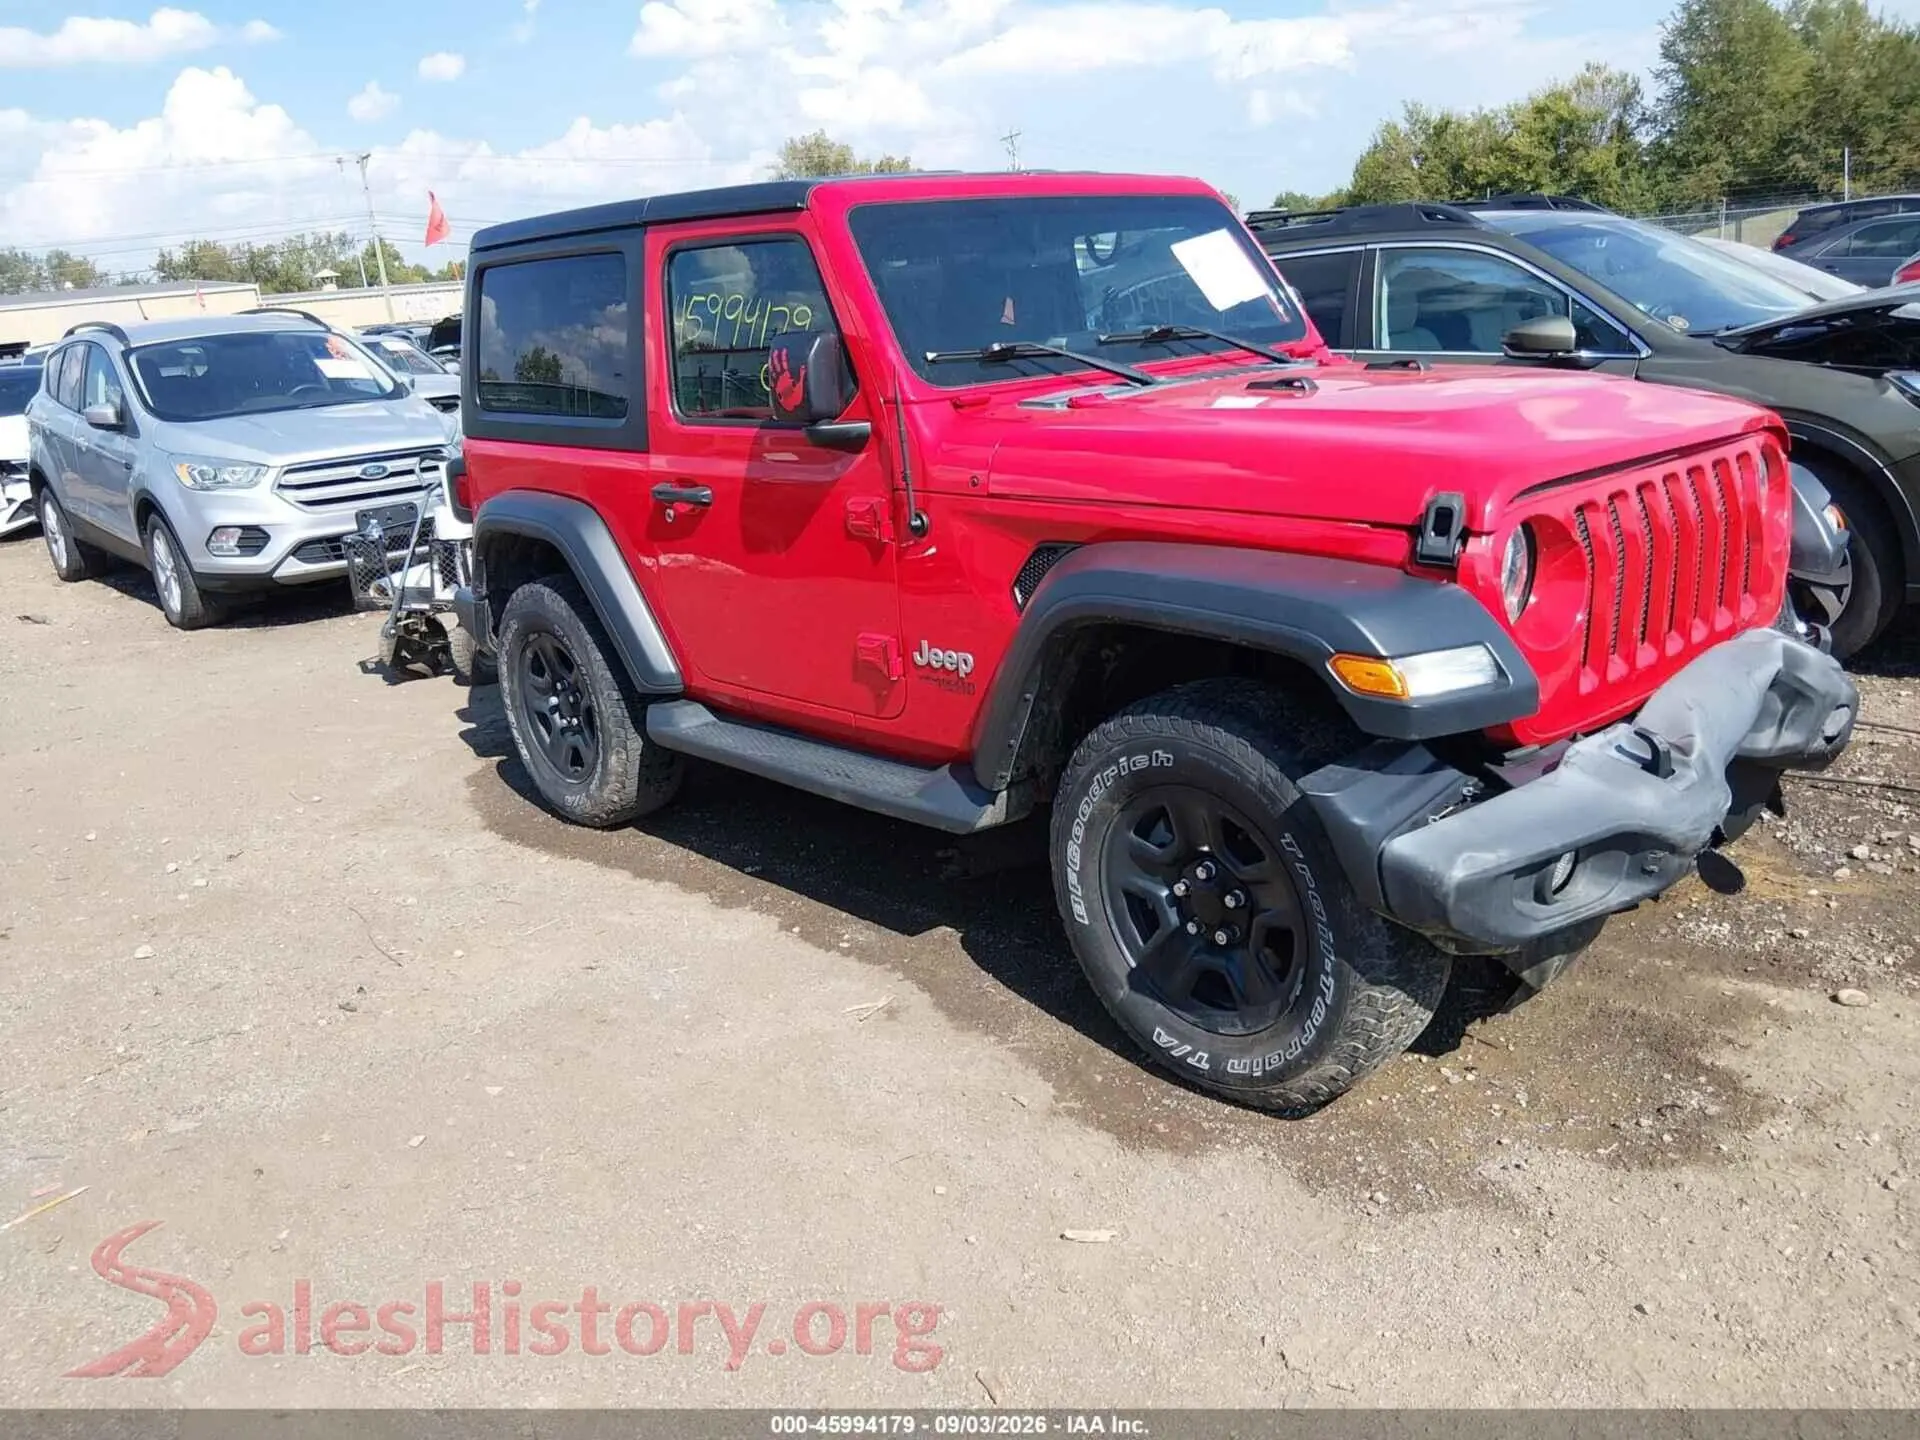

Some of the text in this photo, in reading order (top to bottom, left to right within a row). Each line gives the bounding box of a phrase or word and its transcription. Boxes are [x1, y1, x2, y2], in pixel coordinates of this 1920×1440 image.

[674, 293, 812, 348] 45994179
[913, 639, 974, 679] Jeep
[1067, 750, 1174, 926] BFGoodrich
[1152, 1027, 1210, 1071] T/A
